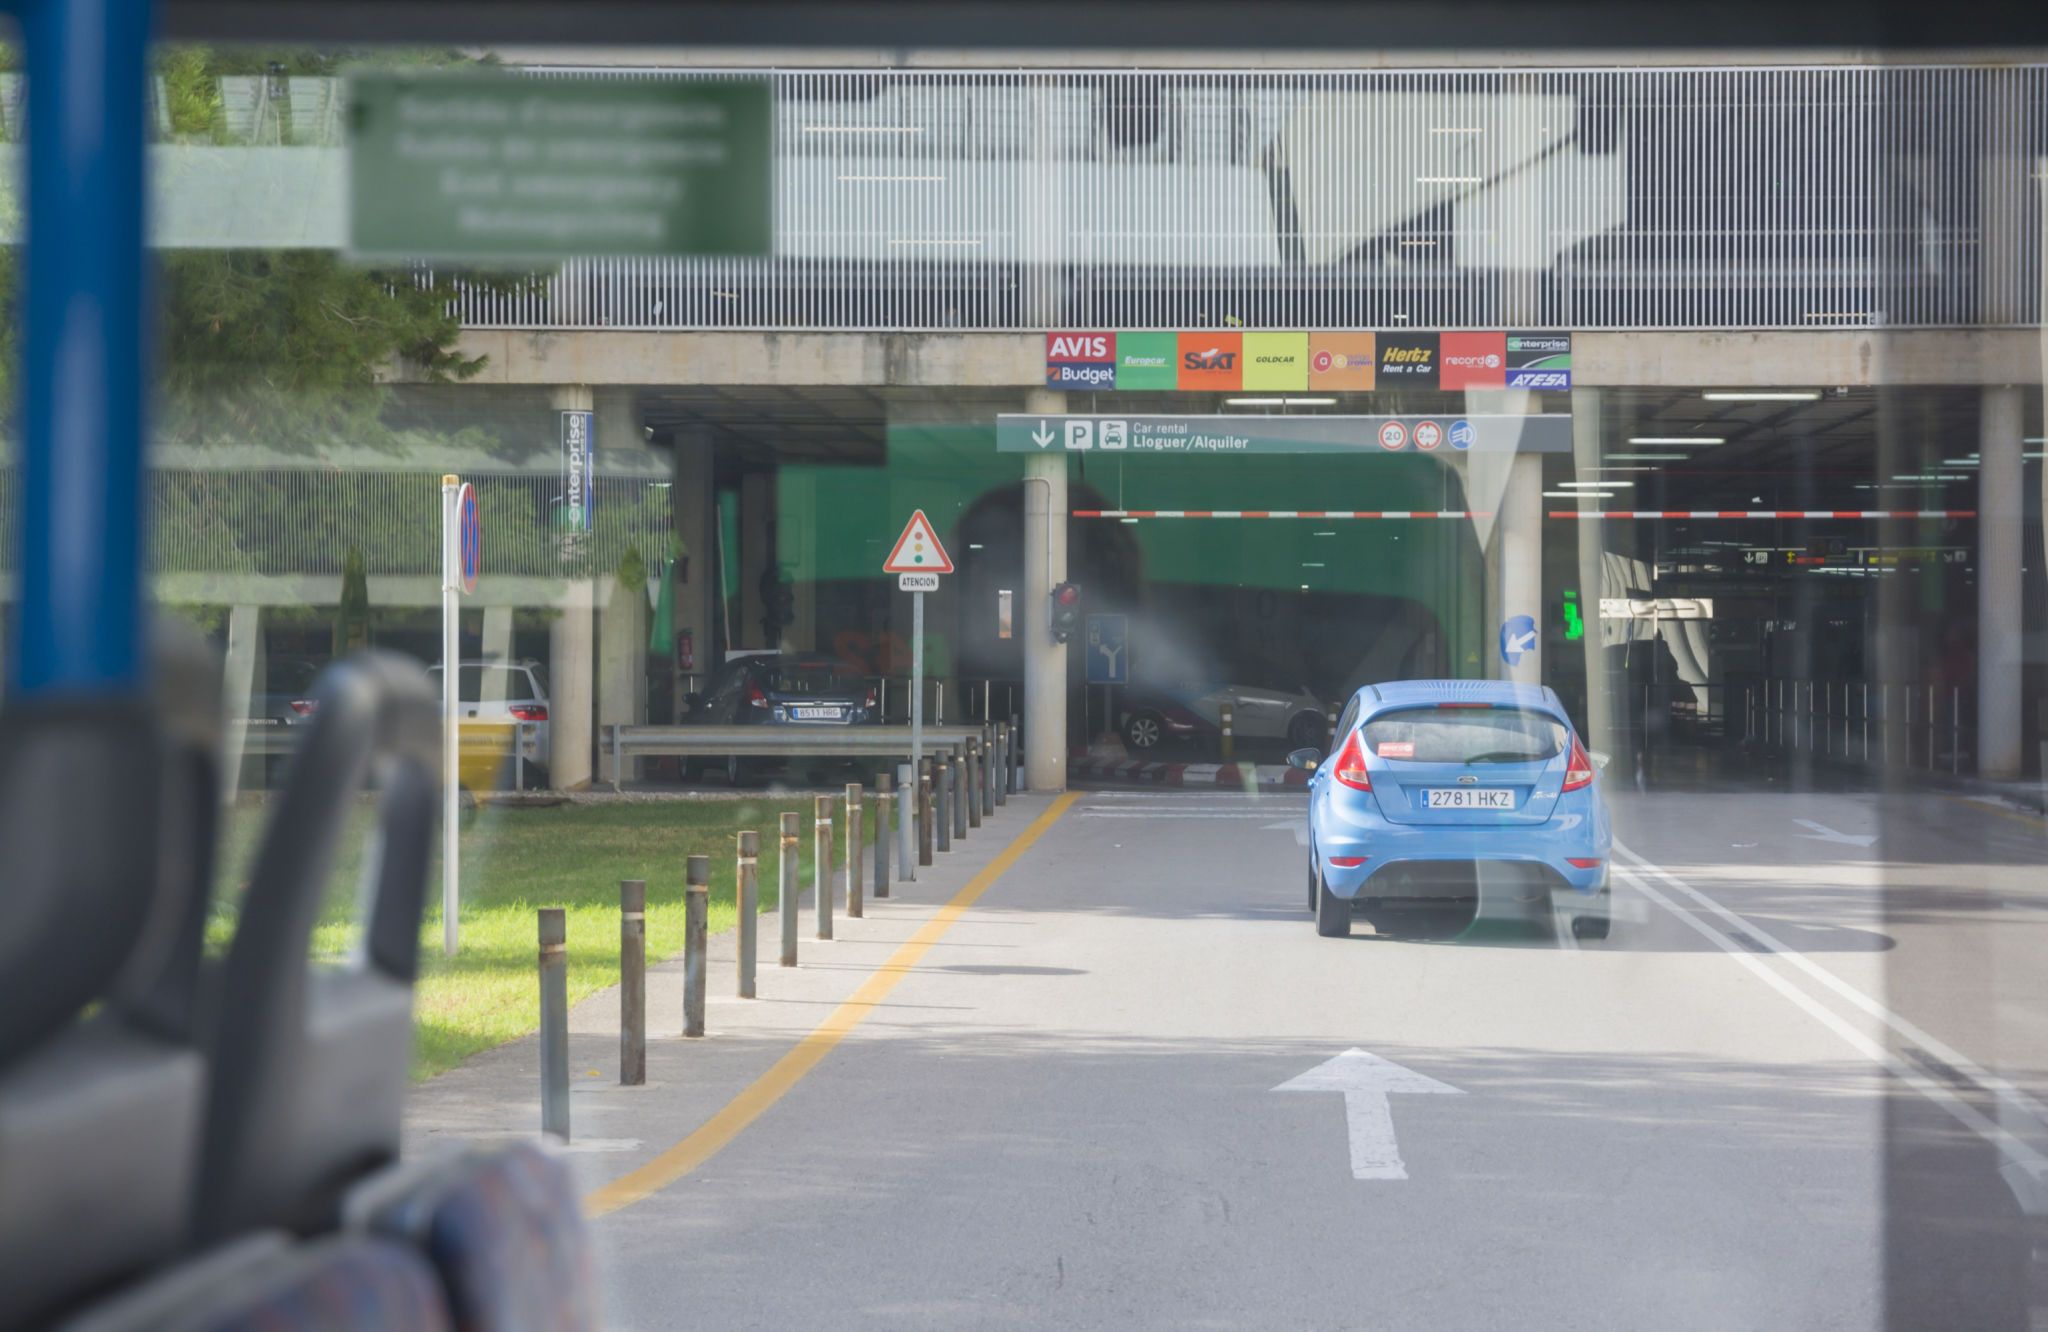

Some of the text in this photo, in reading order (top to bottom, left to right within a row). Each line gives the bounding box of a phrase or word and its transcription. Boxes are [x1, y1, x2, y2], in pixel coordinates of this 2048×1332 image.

[1049, 336, 1108, 358] AVIS
[1510, 339, 1568, 351] enterprise
[1125, 355, 1166, 367] Europcar
[1184, 348, 1237, 371] SIXT
[1256, 356, 1295, 364] GOLDCAR
[1382, 346, 1432, 363] Hertz
[1446, 354, 1485, 366] record
[1061, 367, 1114, 385] Budget
[1382, 364, 1404, 374] Rent
[1416, 364, 1432, 374] Car
[1511, 373, 1568, 387] ATESA
[1133, 422, 1187, 434] Car rental
[1072, 426, 1087, 445] P
[1133, 435, 1249, 450] Lloguer/Alquiler
[1385, 431, 1401, 441] 20
[566, 415, 583, 527] enterprise
[1433, 791, 1509, 806] 2781 HKZ
